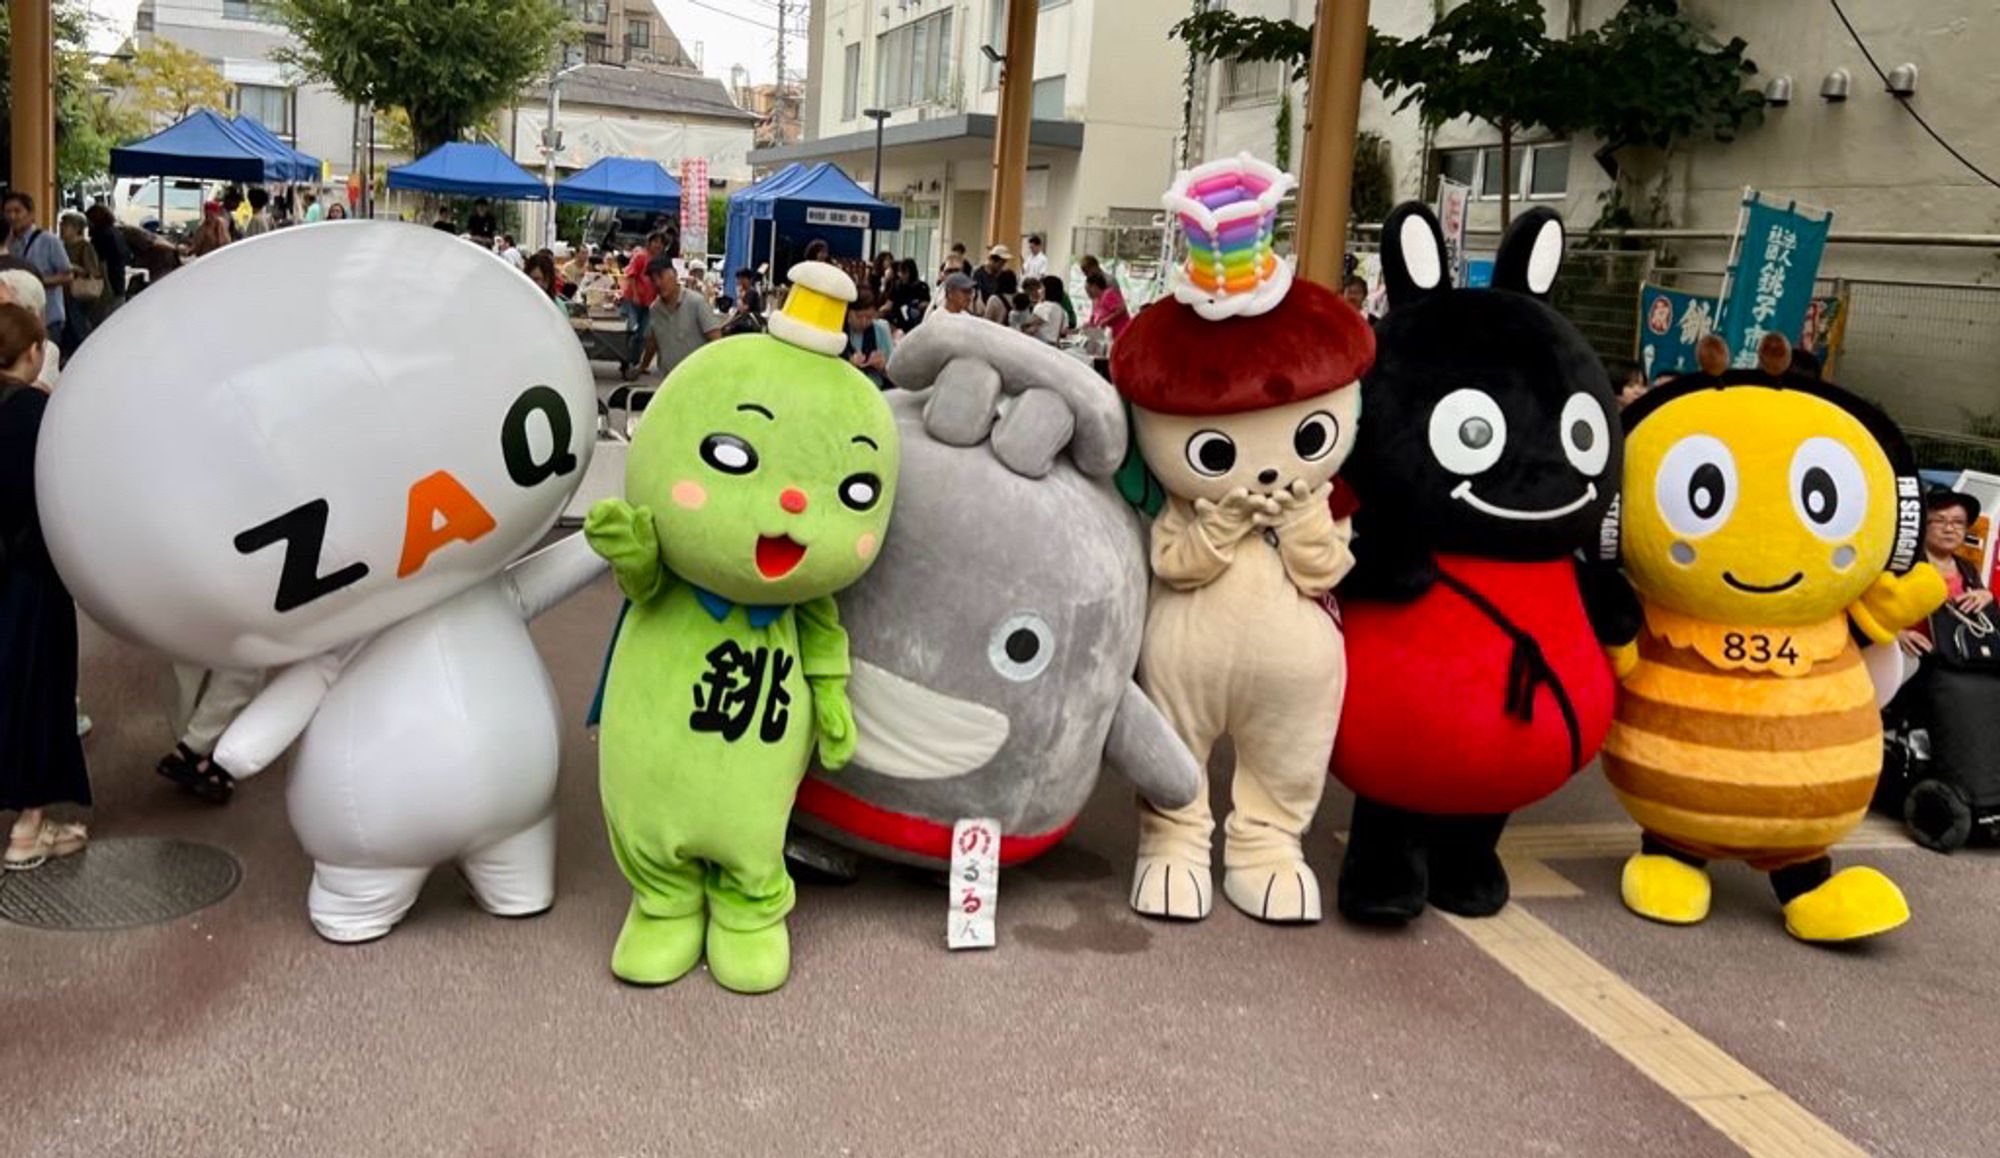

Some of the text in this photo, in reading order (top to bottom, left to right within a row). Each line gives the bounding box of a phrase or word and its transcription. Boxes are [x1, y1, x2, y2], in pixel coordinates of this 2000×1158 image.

[234, 385, 577, 613] ZAQ
[1889, 499, 1920, 571] SETAGAYA
[690, 639, 794, 743] 銚
[1723, 632, 1799, 666] 834
